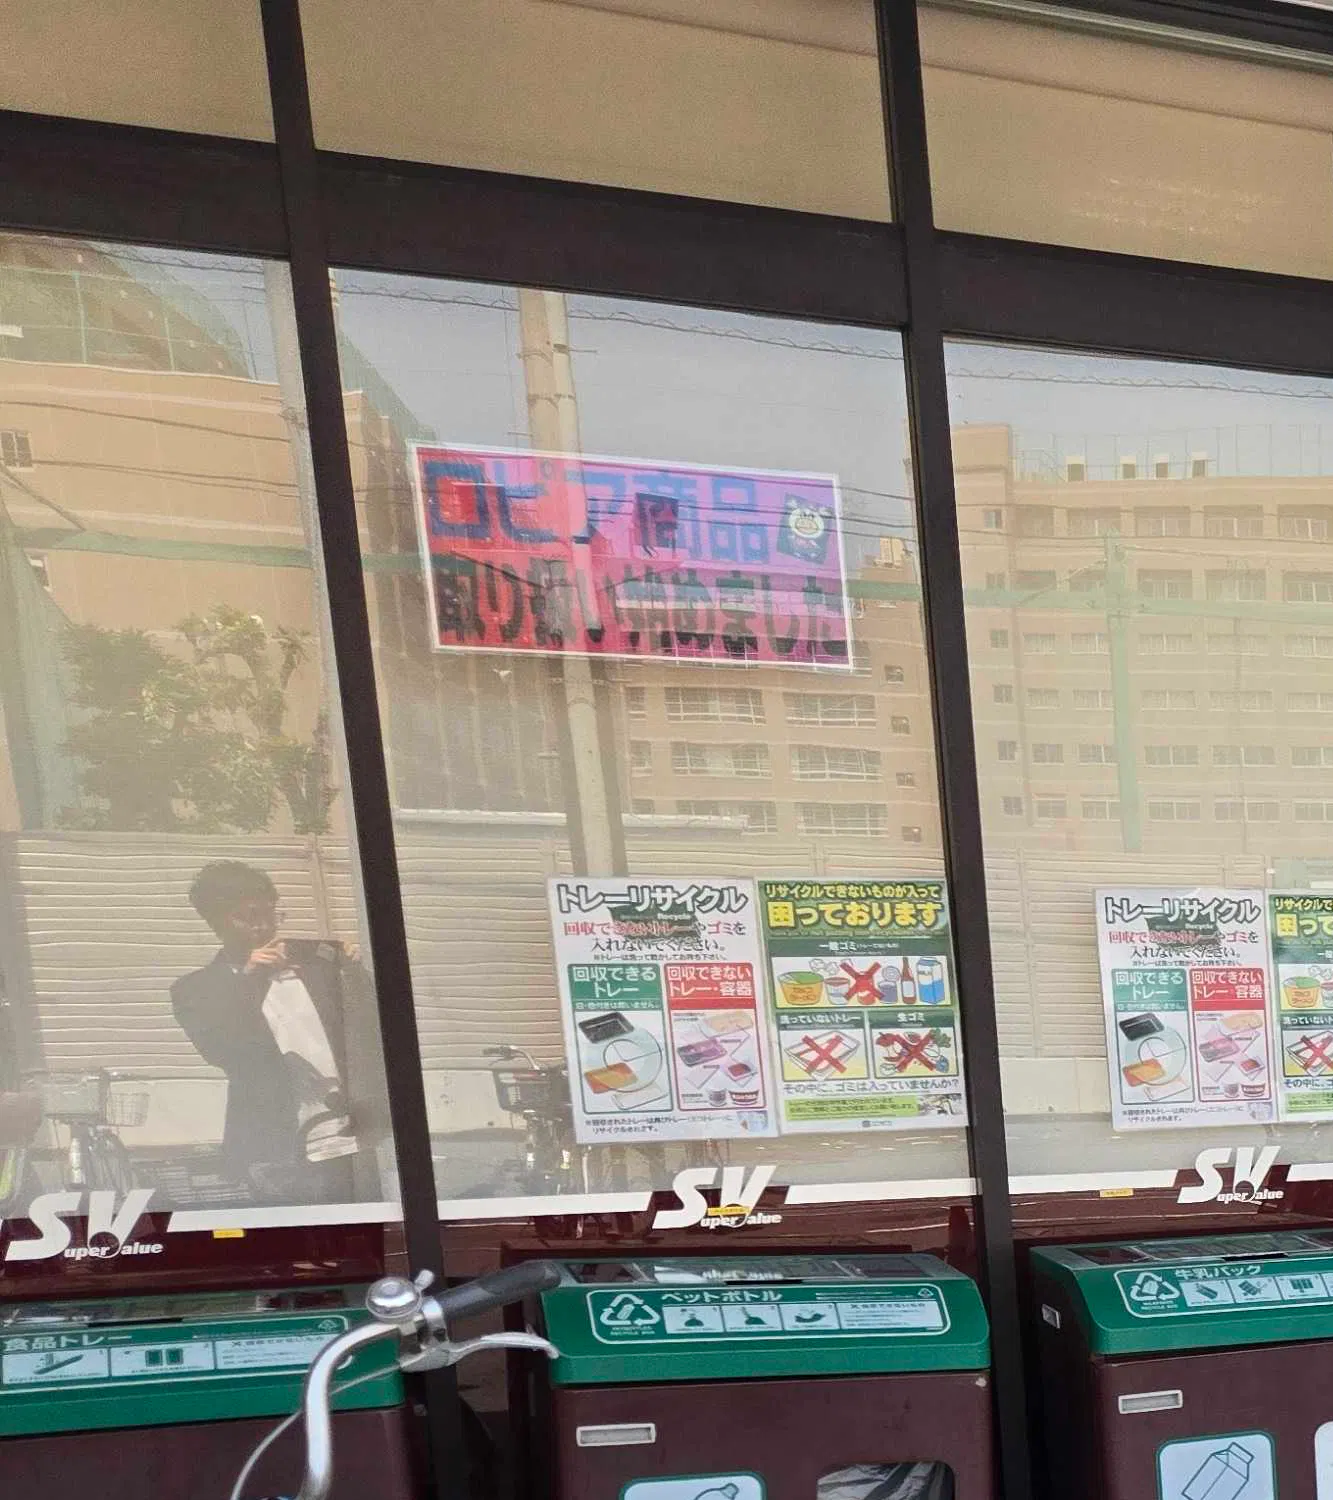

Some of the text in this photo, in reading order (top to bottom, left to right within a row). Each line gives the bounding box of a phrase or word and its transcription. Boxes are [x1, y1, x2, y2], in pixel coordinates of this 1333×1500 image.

[557, 883, 749, 913] トレーリサイクル
[766, 883, 941, 899] リサイクルできないものが入って
[767, 901, 943, 928] 困っております
[1105, 897, 1262, 924] トレーリサイクル
[592, 938, 726, 952] 入れないでください。
[572, 965, 657, 982] 回収できる
[667, 965, 752, 981] 回収できない
[1115, 970, 1184, 985] 回収できる
[1191, 970, 1264, 985] 回収できない
[594, 982, 640, 998] トレー
[669, 980, 753, 997] トレー・容器
[1132, 986, 1170, 1000] トレー
[1177, 1145, 1281, 1204] SV
[652, 1165, 777, 1230] SV
[5, 1188, 157, 1261] SV
[1175, 1265, 1261, 1280] 牛乳パック
[661, 1289, 783, 1303] ペットボトル
[3, 1333, 133, 1352] 食品トレー
